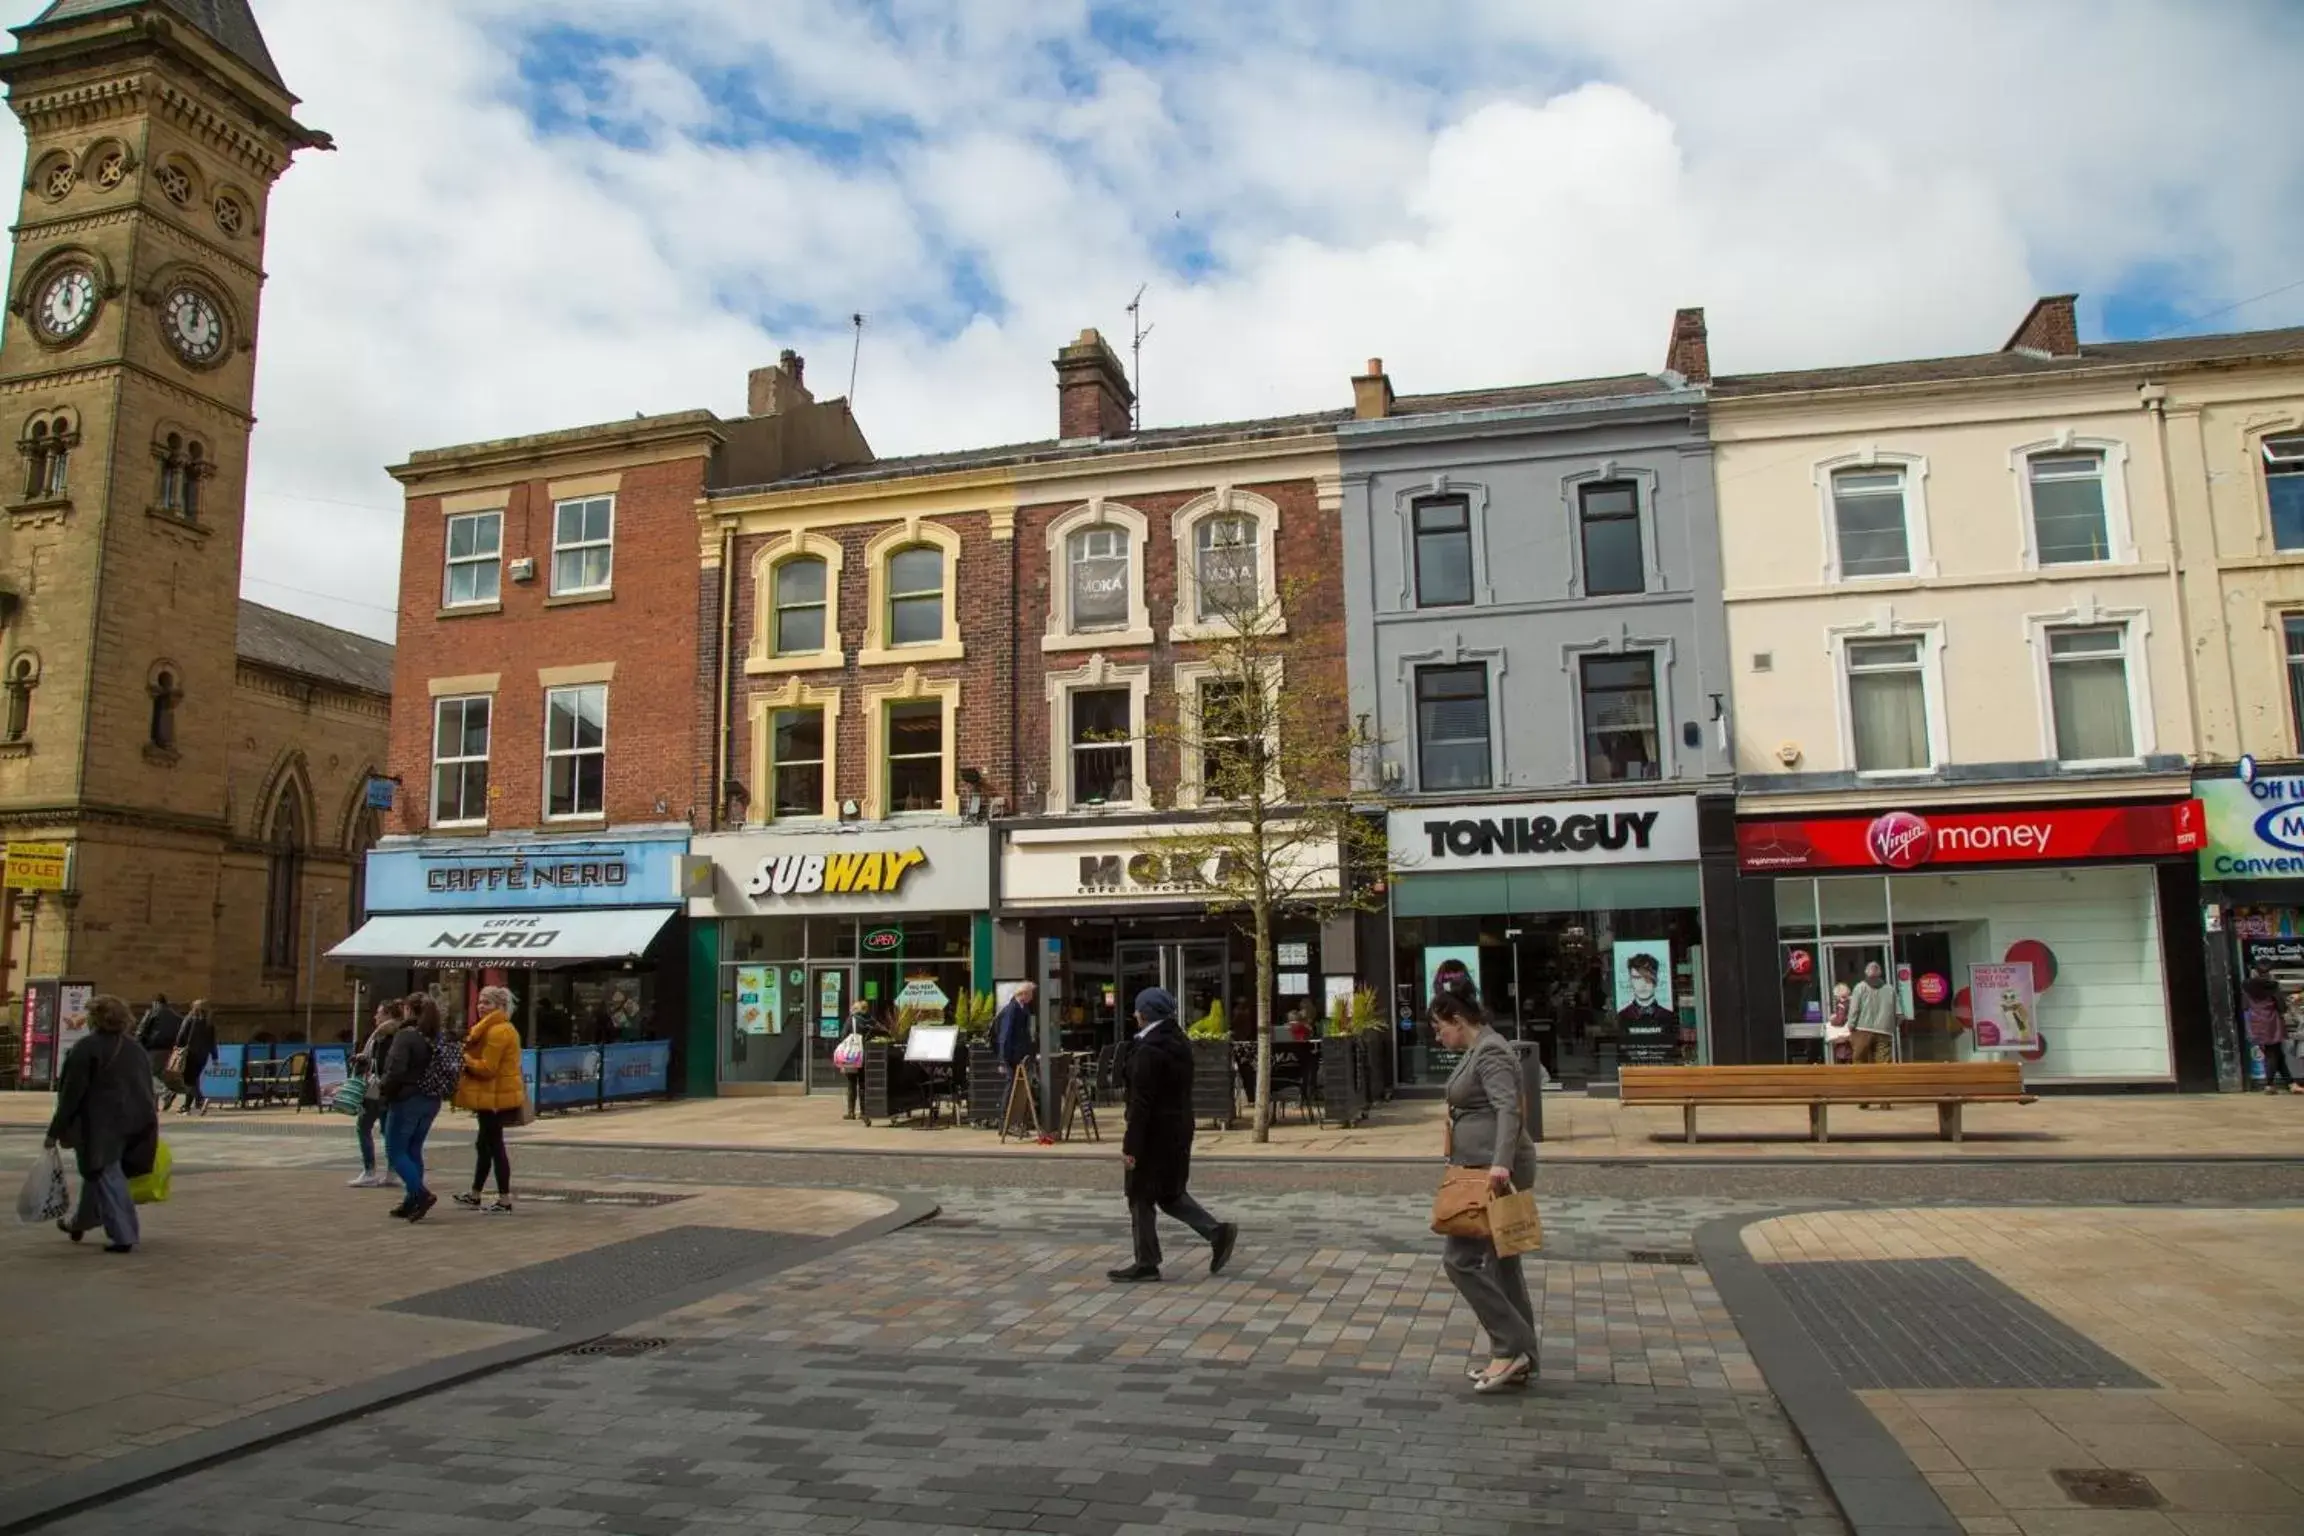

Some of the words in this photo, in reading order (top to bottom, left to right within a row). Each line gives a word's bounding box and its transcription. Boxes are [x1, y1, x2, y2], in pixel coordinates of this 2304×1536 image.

[1081, 579, 1123, 593] MOKA
[2250, 781, 2283, 800] Off
[1424, 811, 1659, 857] TONI&GUY
[1877, 818, 1927, 861] Virgin
[1938, 824, 2052, 853] money
[10, 861, 31, 875] TO
[35, 863, 60, 877] LET
[533, 862, 628, 890] NERO
[749, 846, 926, 897] SUBWAY
[1080, 851, 1245, 885] MOKA
[429, 931, 561, 949] NERO
[867, 933, 897, 946] OPEN
[2251, 944, 2276, 955] Free
[436, 959, 473, 969] ITALIAN
